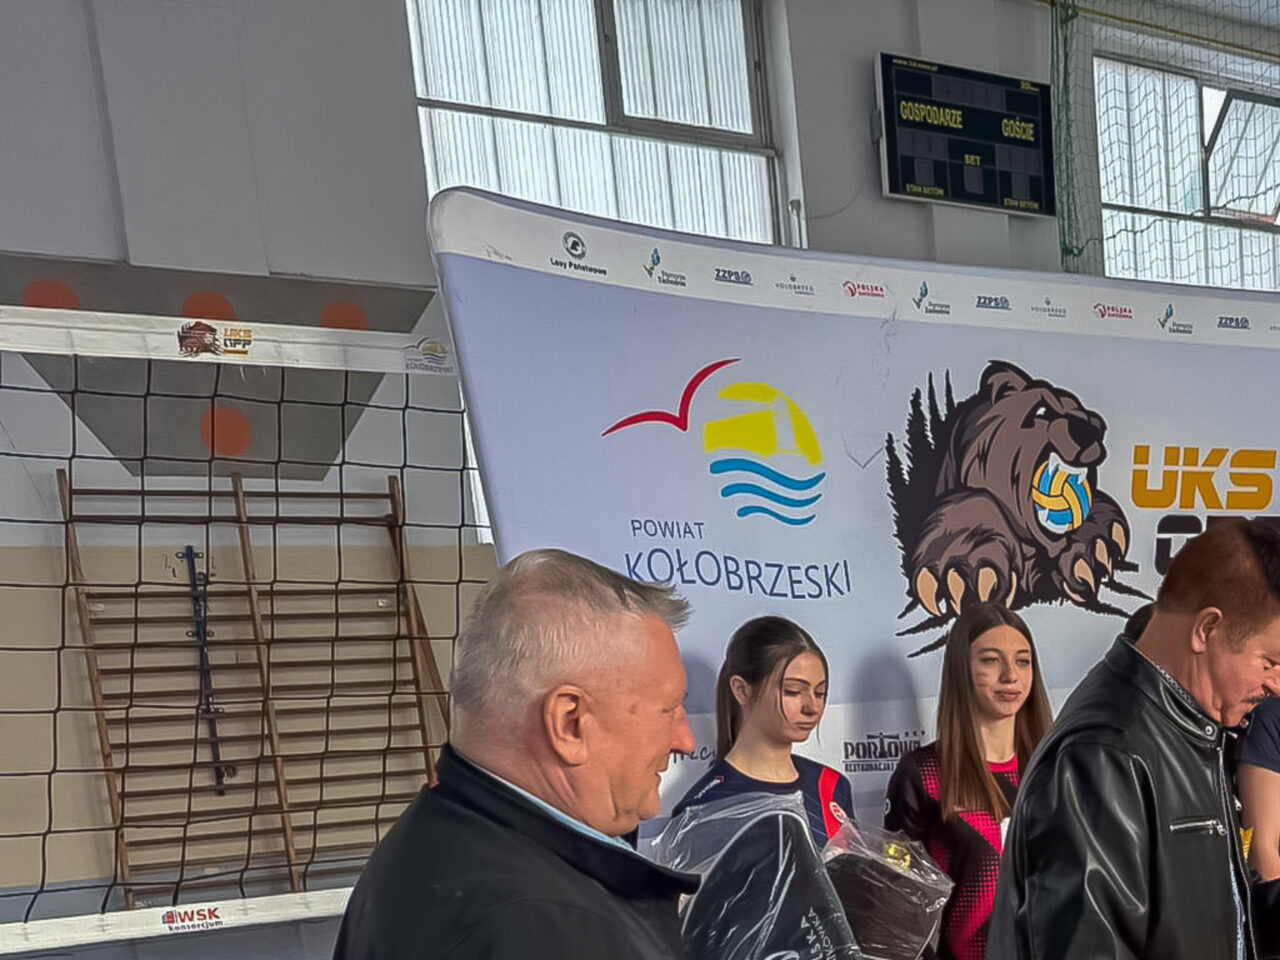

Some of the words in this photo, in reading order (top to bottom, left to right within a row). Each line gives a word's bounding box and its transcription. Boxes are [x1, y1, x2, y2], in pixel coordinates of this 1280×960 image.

[900, 101, 963, 129] GOSPODARZE
[1002, 116, 1035, 141] GOŚCIE
[1132, 445, 1277, 510] UKS
[631, 519, 704, 540] POWIAT
[625, 548, 851, 600] KOŁOBRZESKI
[168, 921, 223, 931] konsorcjum
[178, 907, 220, 922] WSK
